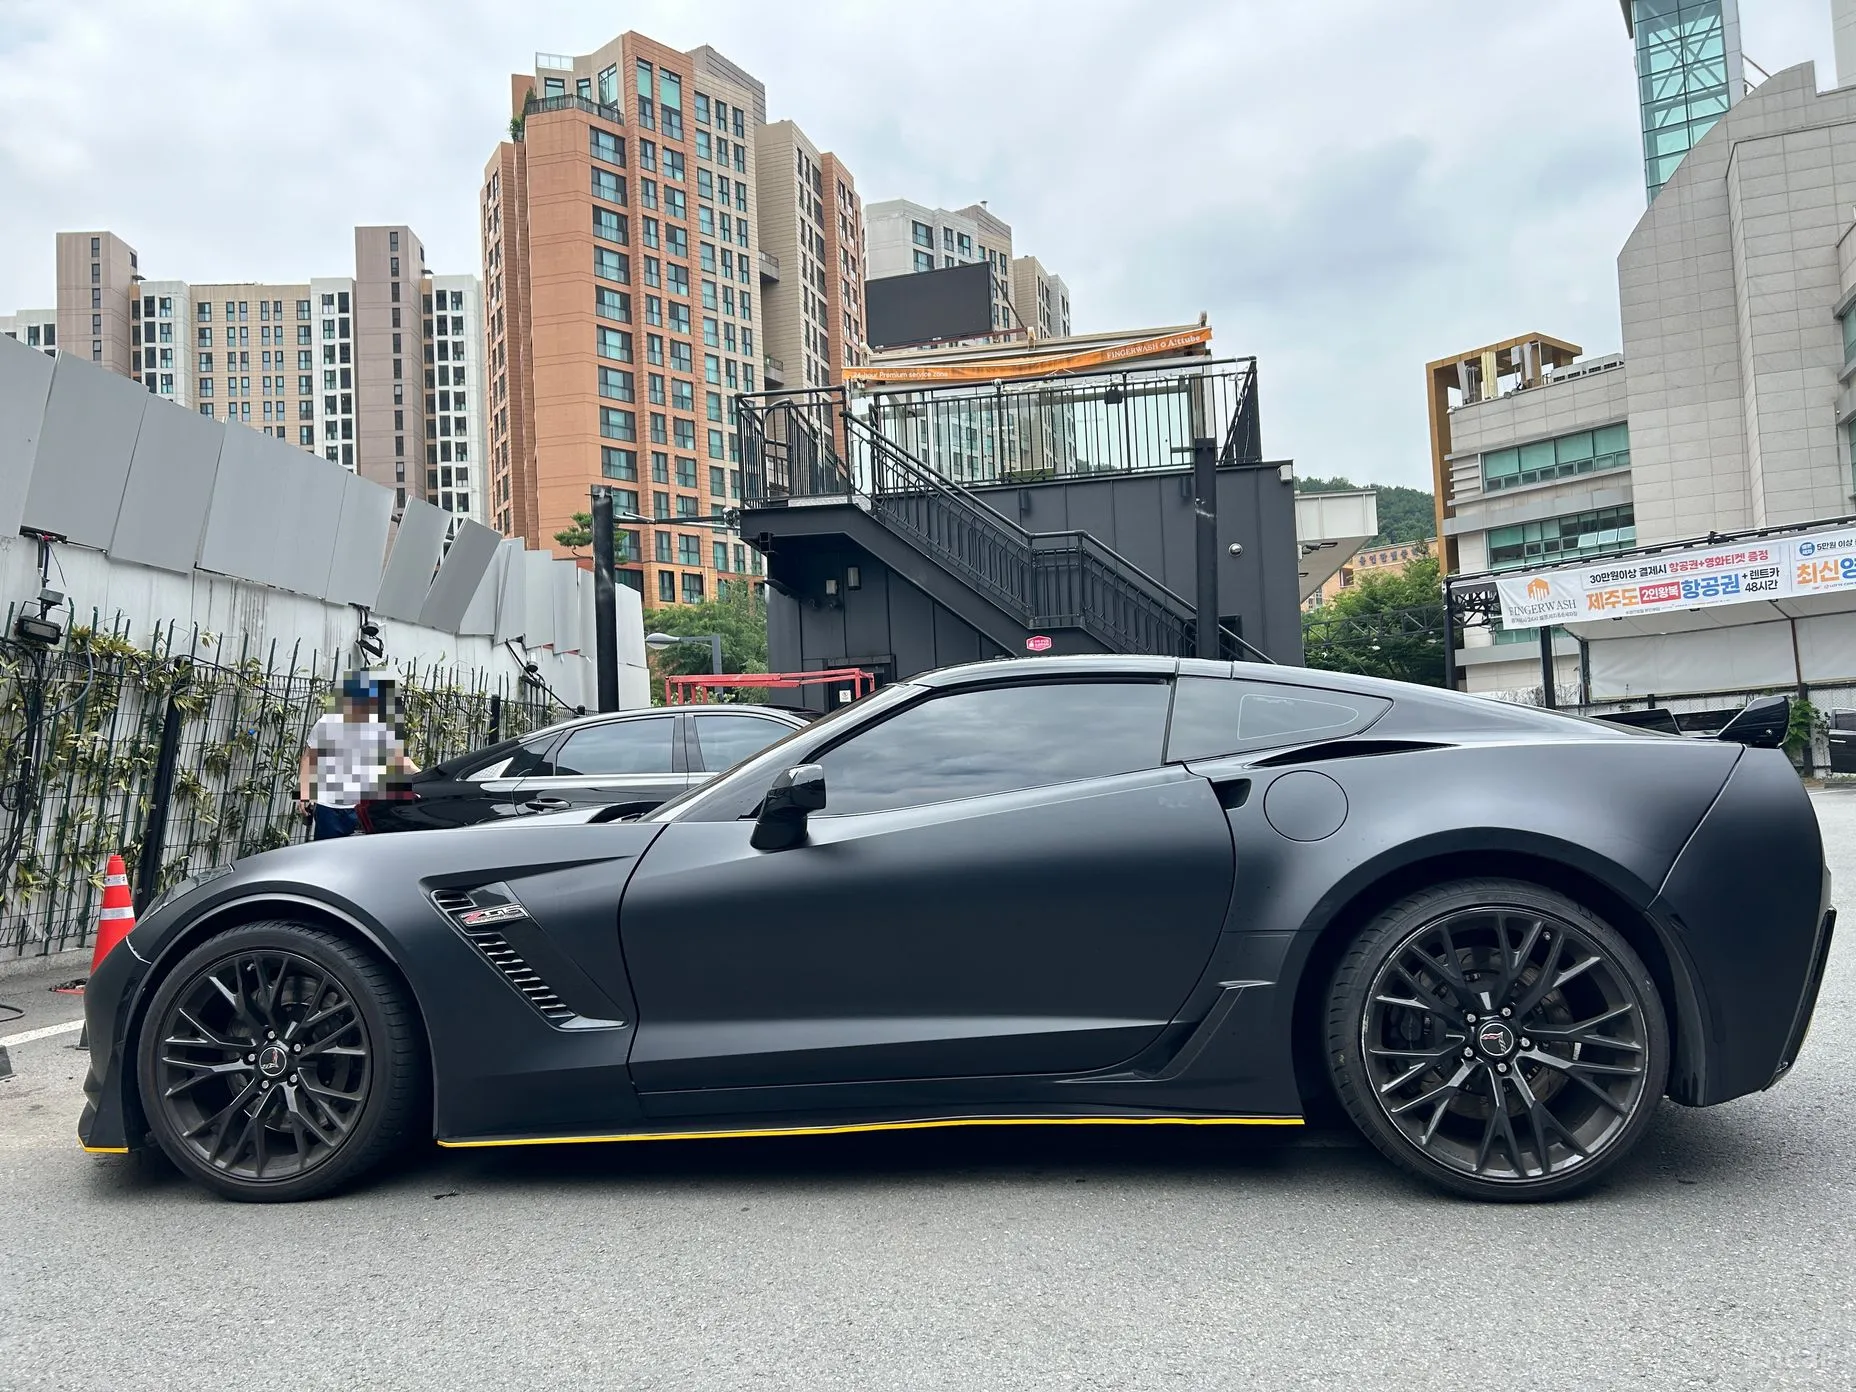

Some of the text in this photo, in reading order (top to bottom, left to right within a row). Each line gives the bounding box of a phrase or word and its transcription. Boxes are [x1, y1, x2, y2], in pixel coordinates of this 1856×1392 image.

[1106, 343, 1158, 359] FINGERWASH
[1817, 541, 1836, 551] 5만원
[1838, 539, 1853, 548] 이상
[1589, 549, 1769, 584] 30만원이상 결제시 항공권+영화티켓 증정
[1749, 567, 1780, 580] 렌트카
[1586, 587, 1640, 611] 제주도
[1641, 584, 1679, 601] 2인왕복
[1681, 573, 1740, 600] 항공권
[1744, 579, 1778, 593] 48시간
[1508, 599, 1577, 616] FINGERWASH
